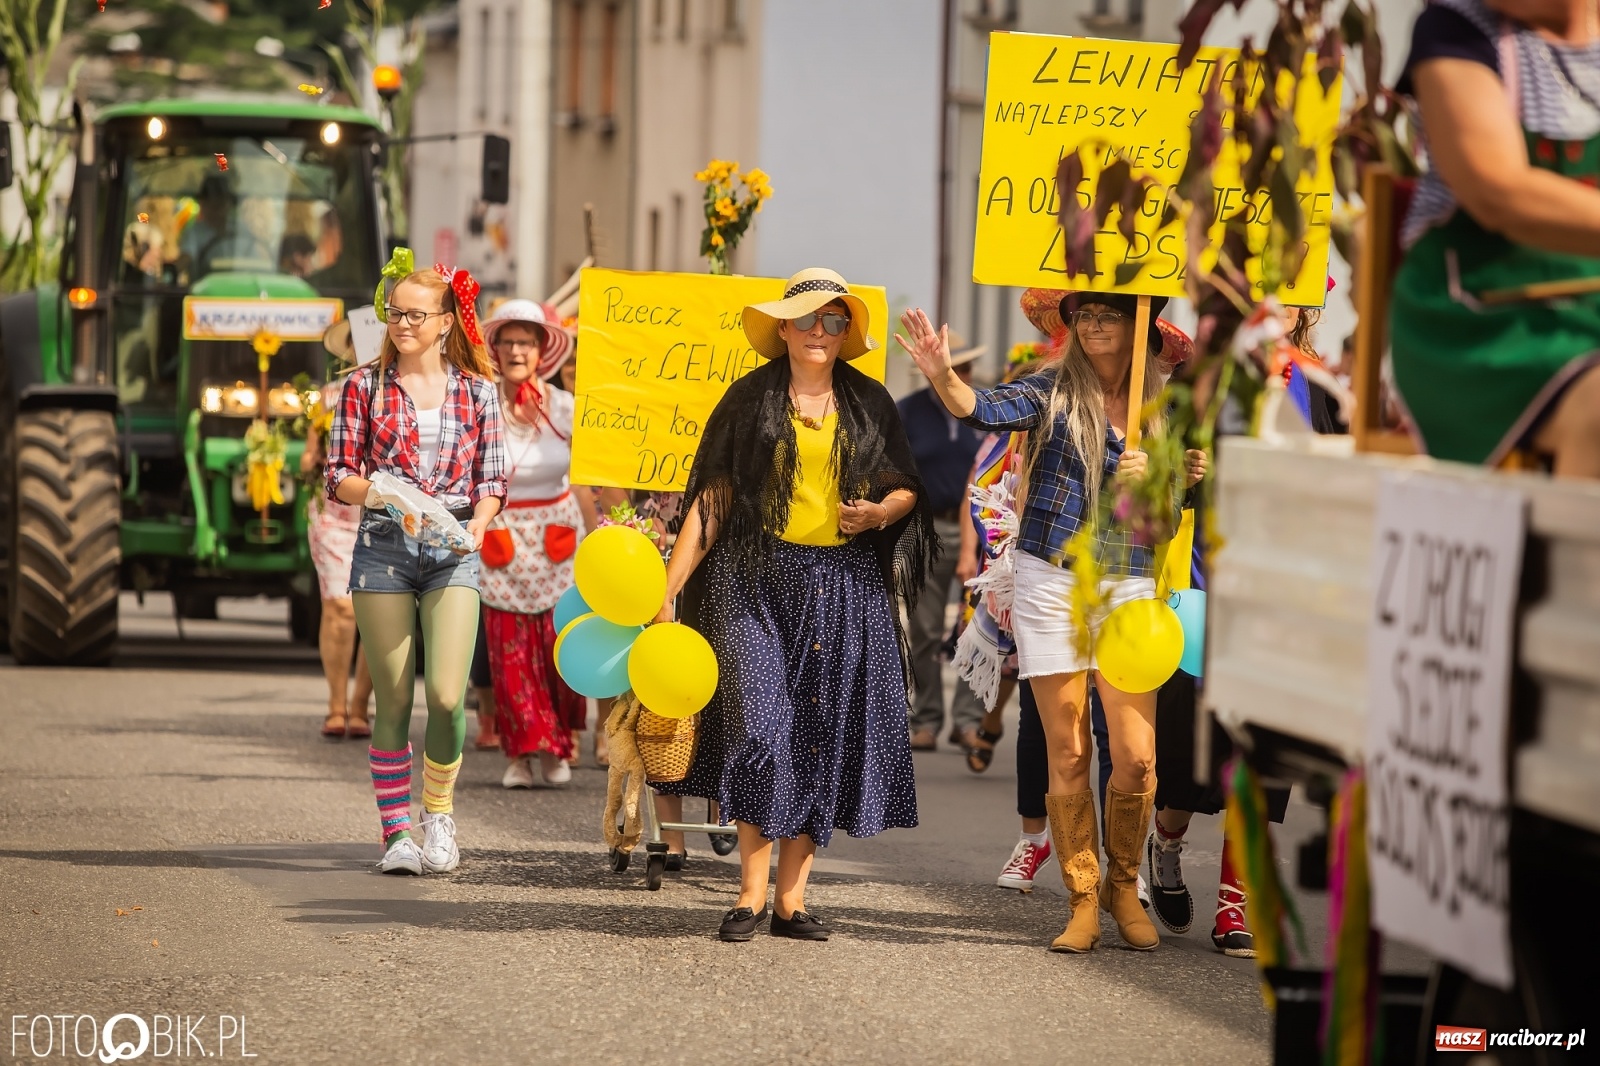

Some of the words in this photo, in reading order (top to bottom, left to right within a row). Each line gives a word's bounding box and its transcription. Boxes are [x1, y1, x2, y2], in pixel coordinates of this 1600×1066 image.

[994, 101, 1148, 136] NAJLEPSZY
[985, 176, 1014, 216] A
[603, 286, 683, 327] Rzecz
[580, 394, 650, 448] każdy
